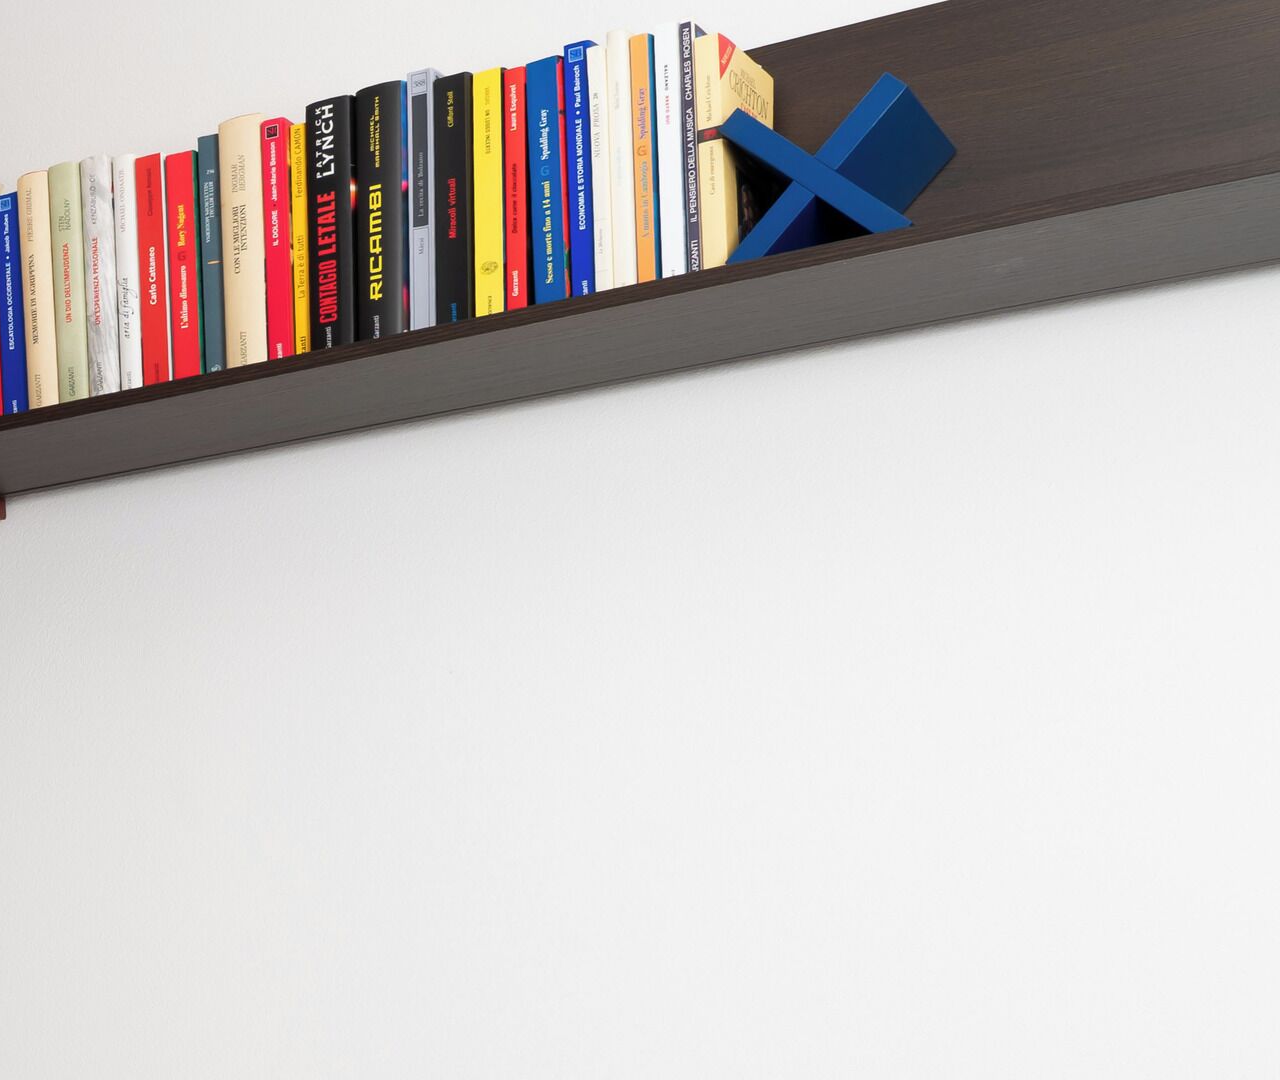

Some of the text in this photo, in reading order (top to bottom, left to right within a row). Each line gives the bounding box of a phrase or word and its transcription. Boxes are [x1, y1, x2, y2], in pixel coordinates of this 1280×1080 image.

[573, 64, 581, 92] Bairoch
[682, 28, 692, 101] CHARLES ROSEN
[315, 107, 323, 179] PATRICK
[321, 104, 335, 177] LYNCH
[540, 108, 550, 161] Spalding Gray
[575, 118, 583, 159] MONDIALE
[592, 104, 601, 158] NUOVA PROSA
[270, 166, 278, 202] Jean-Marie
[293, 128, 303, 199] Ferdinando CAMON
[576, 160, 585, 184] STORIA
[686, 107, 697, 223] IL PENSIERO DELLA MUSICA
[89, 185, 97, 225] KENZABURO
[418, 208, 424, 217] La
[448, 178, 457, 240] Miracoli virtuali
[542, 180, 551, 198] anni
[542, 198, 551, 209] 14
[578, 190, 586, 231] ECONOMIA
[64, 198, 72, 231] NADOLNY
[177, 204, 186, 247] Rory Nugent
[232, 205, 241, 244] MIGLIORI
[240, 204, 248, 252] INTENZIONI
[542, 216, 552, 232] fino
[234, 246, 241, 256] LE
[316, 191, 338, 324] CONTAGIO LETALE
[369, 184, 383, 301] RICAMBI
[62, 243, 72, 323] UN DIO DELL'IMPUDENZA
[148, 246, 158, 306] Carlo Cattaneo
[297, 234, 306, 300] La Terra di tutti
[28, 254, 40, 345] MEMORIE DI AGRIPPINA
[92, 278, 101, 326] UN'ESPERIENZA
[119, 278, 138, 315] famiglia
[179, 265, 189, 329] L'ultimo dinosauro
[68, 366, 76, 397] GARZANTI
